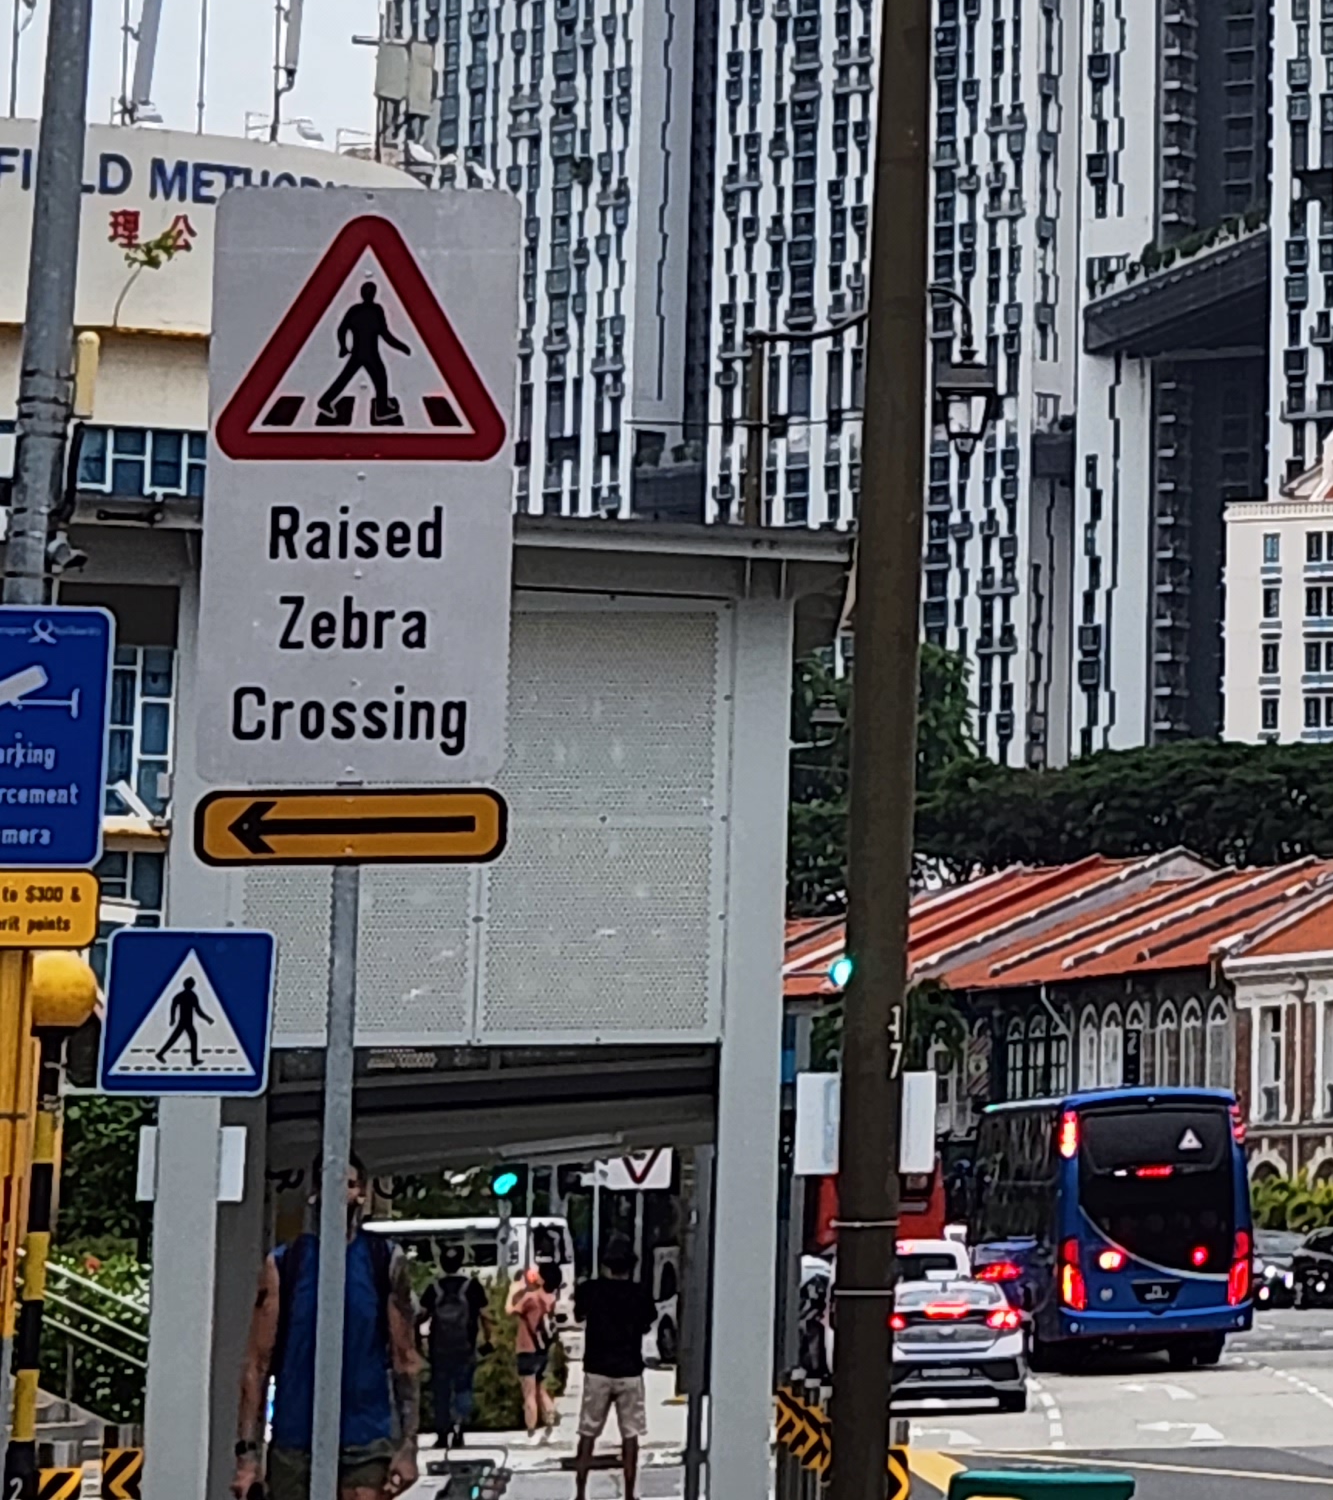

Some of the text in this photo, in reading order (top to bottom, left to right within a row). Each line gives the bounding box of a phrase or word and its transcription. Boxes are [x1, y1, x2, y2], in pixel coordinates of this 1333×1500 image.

[269, 505, 443, 560] Raised
[279, 595, 427, 649] Zebra
[232, 686, 467, 756] Crossing
[25, 885, 64, 904] $300
[27, 915, 71, 936] points
